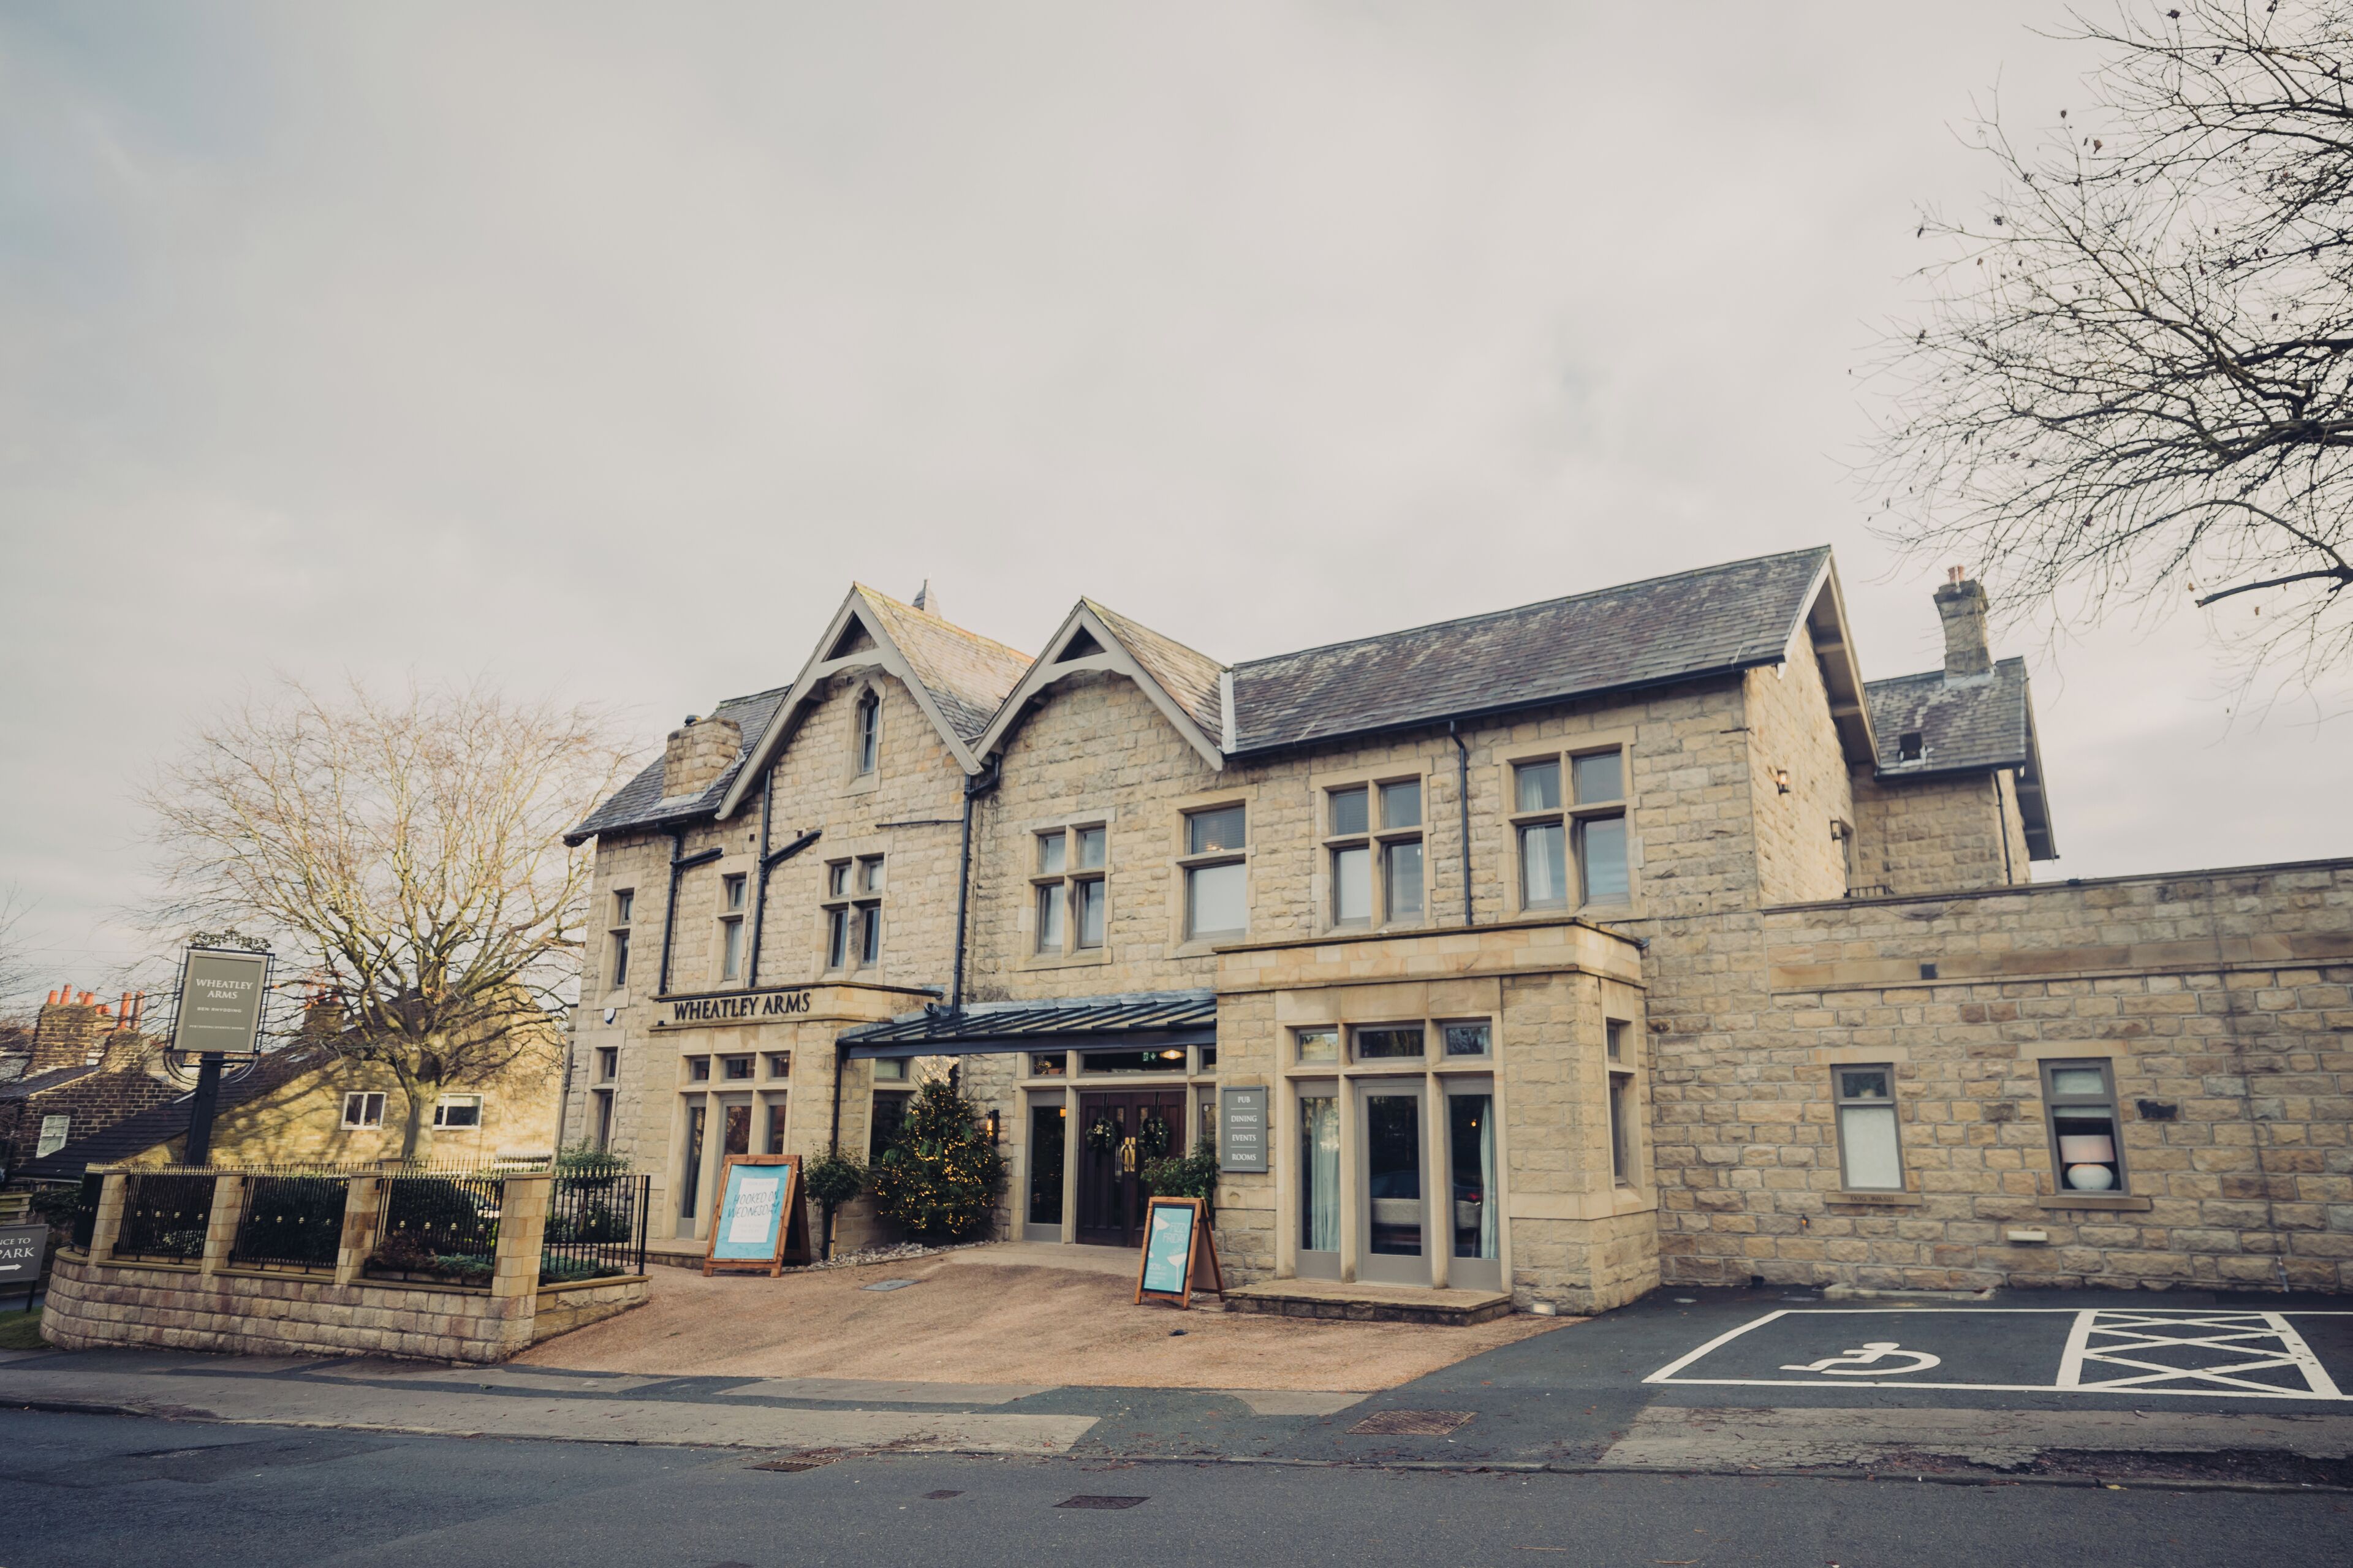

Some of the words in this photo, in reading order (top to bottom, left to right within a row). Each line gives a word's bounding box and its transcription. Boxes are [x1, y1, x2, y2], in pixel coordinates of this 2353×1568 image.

[196, 979, 253, 990] WHEATLEY
[207, 990, 238, 999] ARMS
[673, 996, 759, 1020] WHEATLEY
[762, 992, 811, 1015] ARMS
[733, 1191, 766, 1205] HOOKED
[768, 1189, 779, 1202] ON
[727, 1201, 780, 1218] WEDNESDAY
[1170, 1222, 1189, 1233] FIZZY
[1162, 1232, 1188, 1243] FRIDAY
